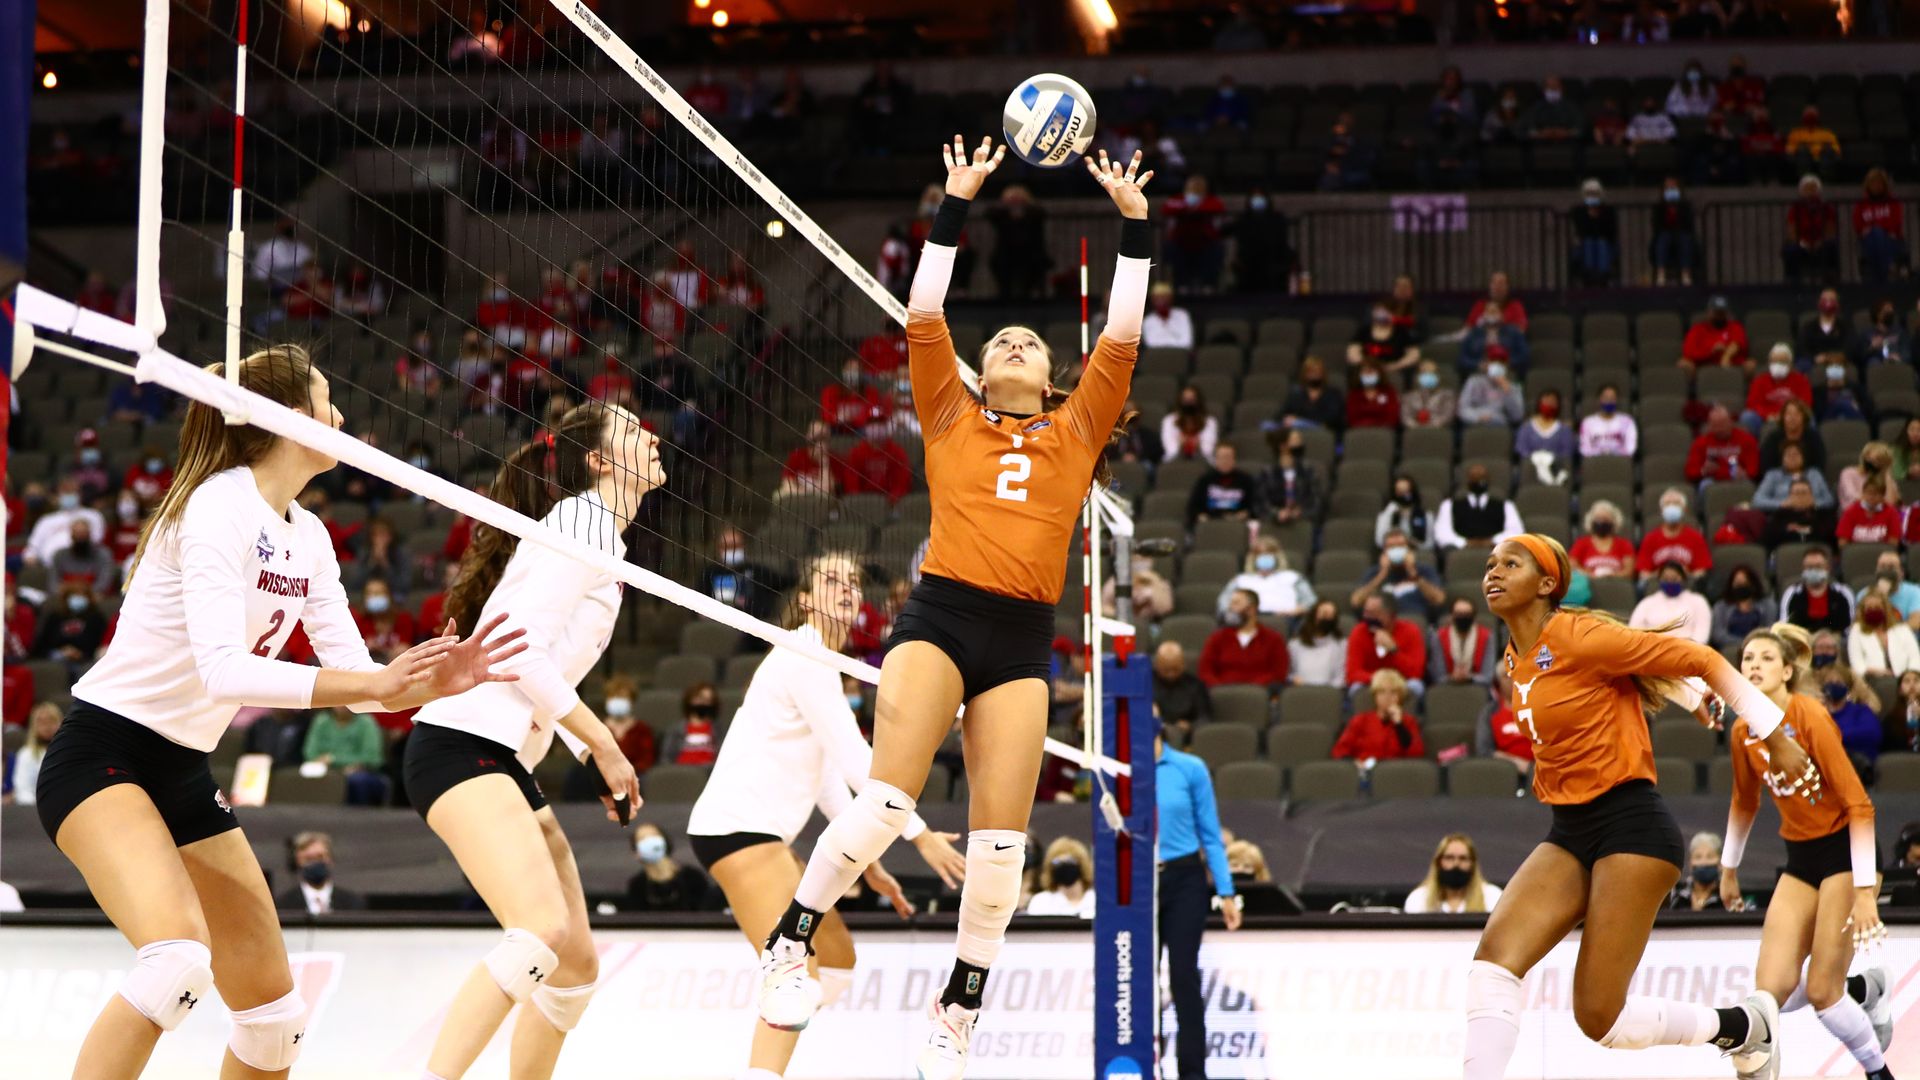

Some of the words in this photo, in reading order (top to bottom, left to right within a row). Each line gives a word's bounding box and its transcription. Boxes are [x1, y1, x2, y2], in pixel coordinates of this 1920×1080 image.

[1049, 116, 1082, 162] molten
[995, 453, 1032, 502] 2
[250, 608, 286, 659] 2
[1517, 708, 1543, 745] 7
[1114, 930, 1134, 982] sports
[1114, 982, 1134, 1046] imports
[974, 1031, 1066, 1058] OSTED
